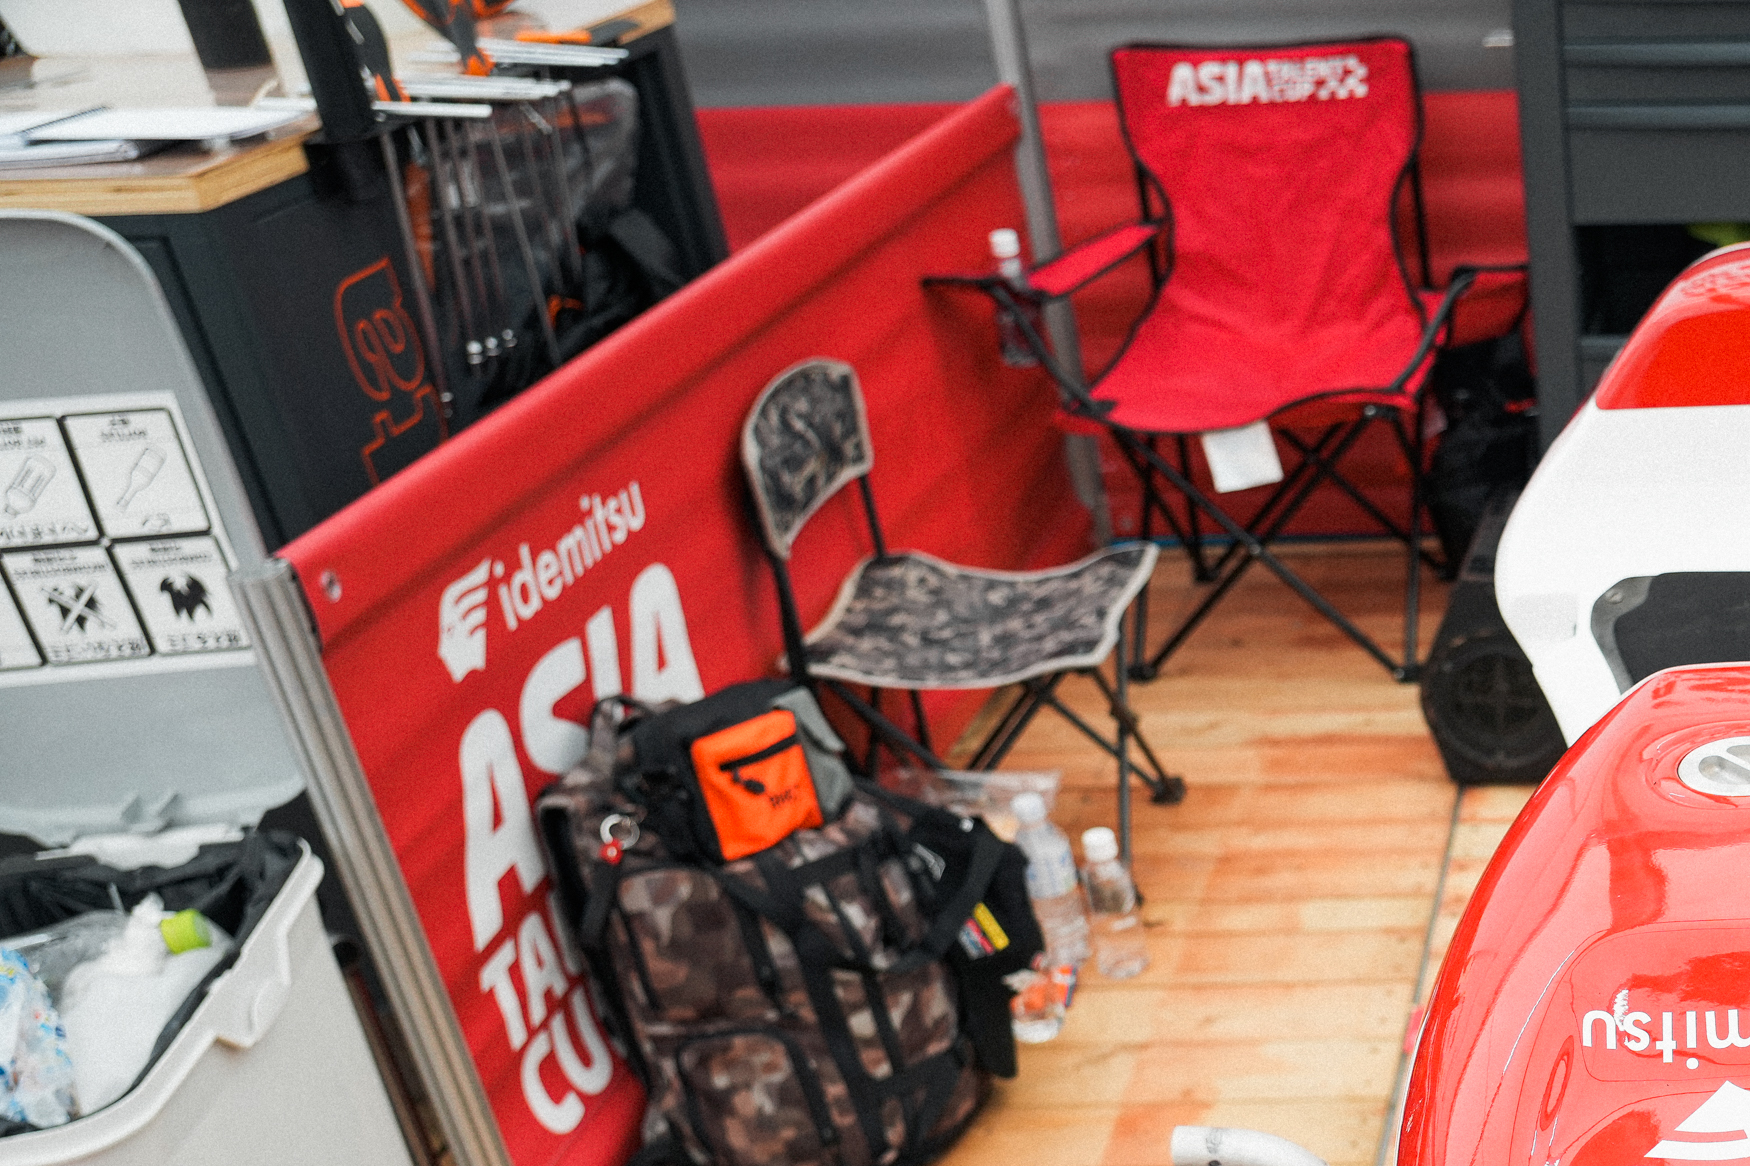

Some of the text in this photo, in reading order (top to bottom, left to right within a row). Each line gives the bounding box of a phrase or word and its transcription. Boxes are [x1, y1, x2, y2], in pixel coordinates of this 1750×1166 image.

[1167, 58, 1269, 107] ASIA
[493, 480, 646, 632] idemitsu
[458, 561, 706, 955] ASIA
[520, 985, 614, 1135] CU
